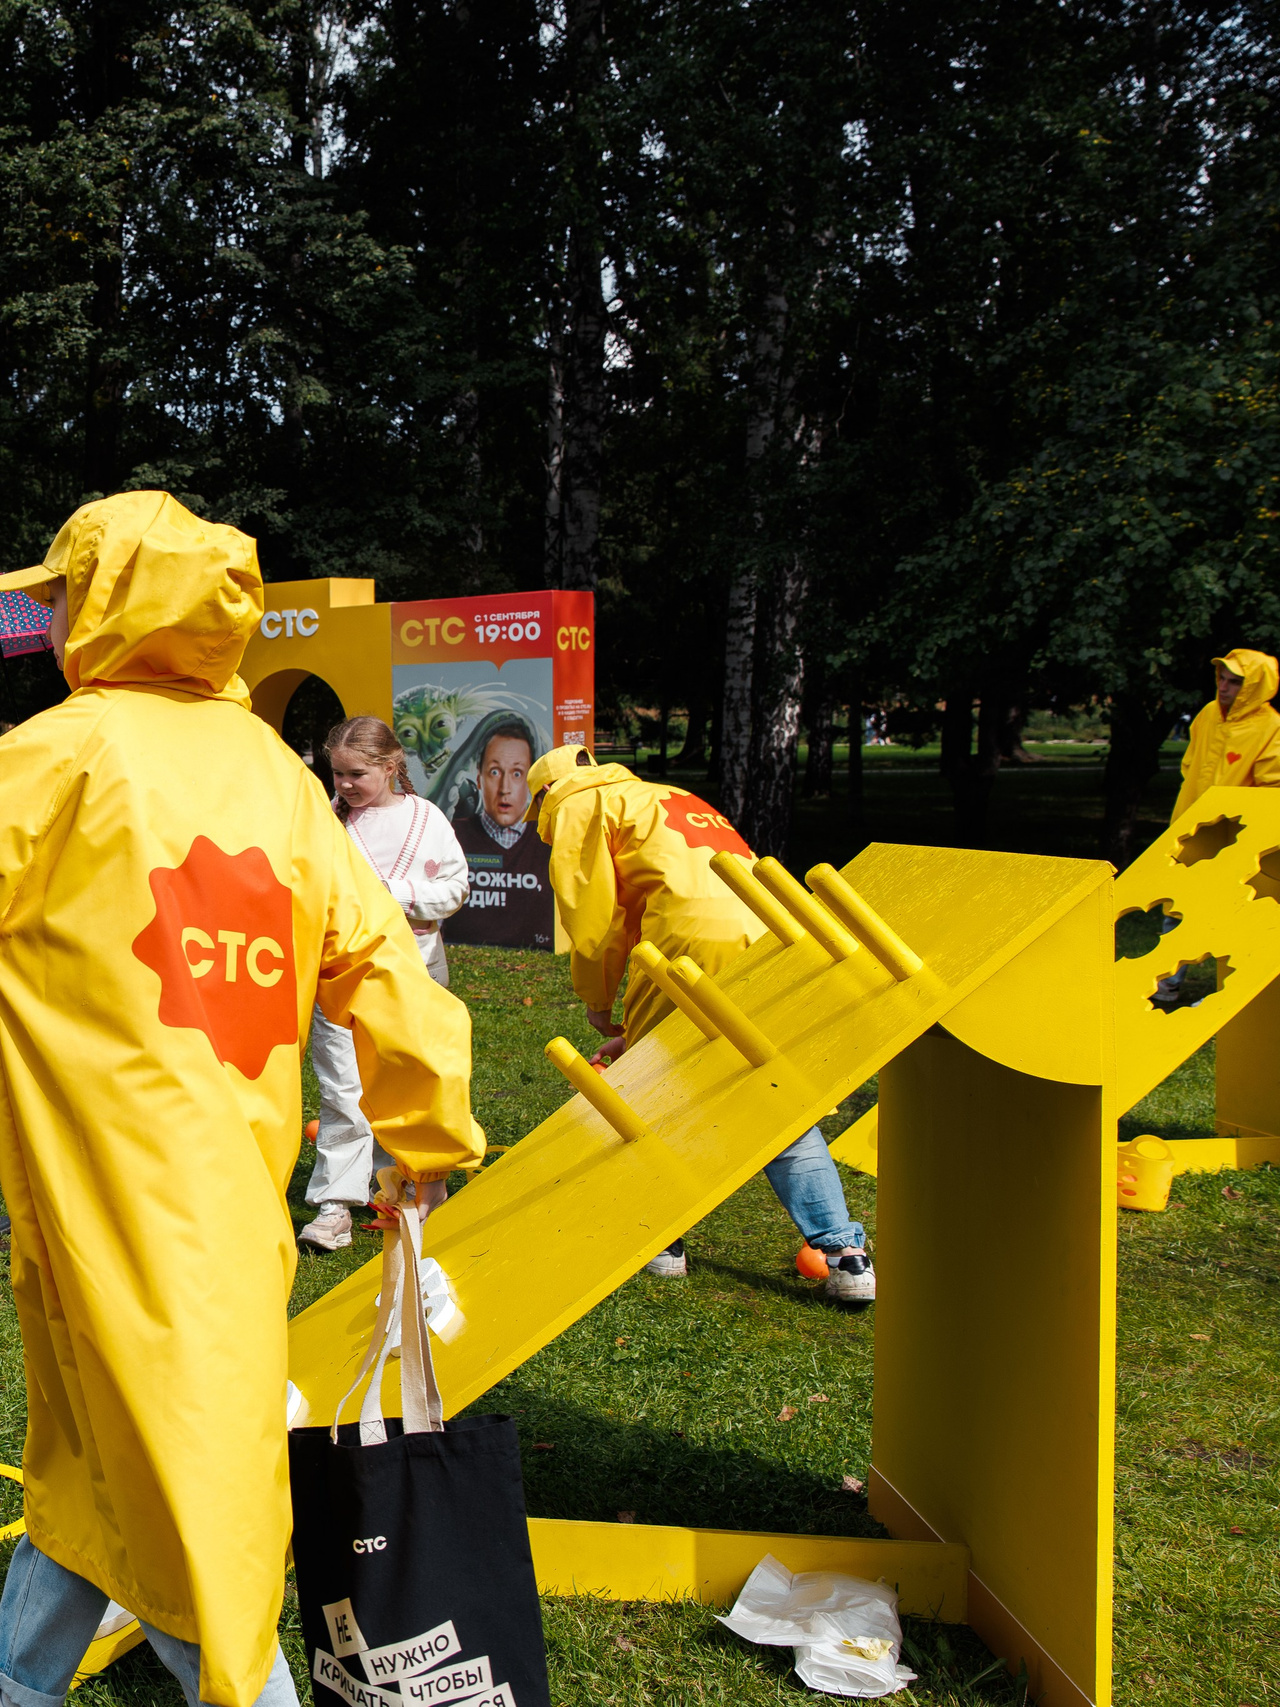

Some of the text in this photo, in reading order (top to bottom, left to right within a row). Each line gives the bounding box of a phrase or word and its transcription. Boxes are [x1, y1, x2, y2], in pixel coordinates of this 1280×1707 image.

[260, 608, 319, 639] СТС
[474, 611, 540, 623] С 1 СЕНТЯБРЯ
[400, 616, 466, 648] СТС
[474, 621, 541, 644] 19:00
[556, 626, 591, 651] СТС
[685, 812, 736, 832] СТС
[467, 871, 542, 892] РОЖНО,
[463, 890, 507, 909] ДИ!
[534, 933, 550, 944] 16+
[181, 926, 285, 988] СТС
[352, 1535, 388, 1554] СТС
[334, 1613, 450, 1676] НЕ НУЖНО
[319, 1658, 484, 1707] КРИЧАТЬ ЧТОБЫ
